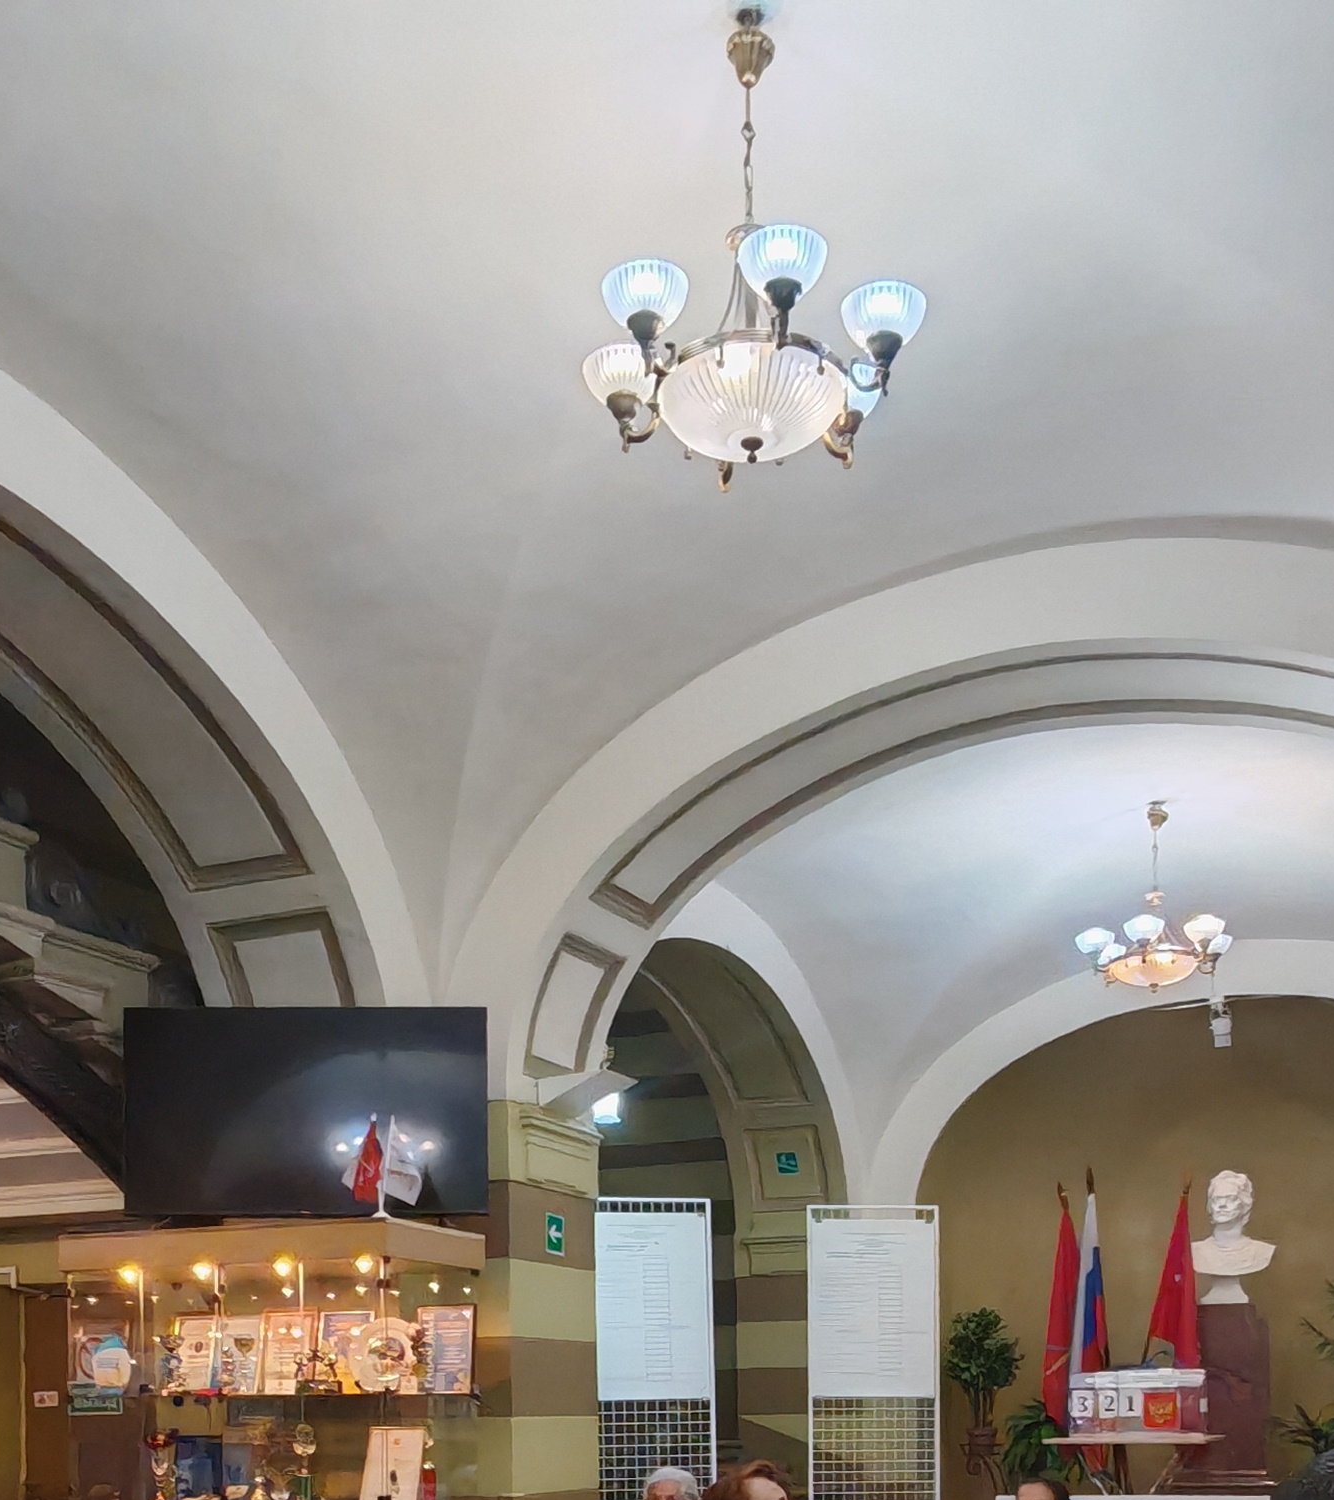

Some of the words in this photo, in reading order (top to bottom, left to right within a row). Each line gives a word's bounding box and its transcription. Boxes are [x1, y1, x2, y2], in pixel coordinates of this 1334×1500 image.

[1077, 1395, 1089, 1413] 3
[1104, 1395, 1116, 1412] 2
[1127, 1395, 1135, 1412] 1
